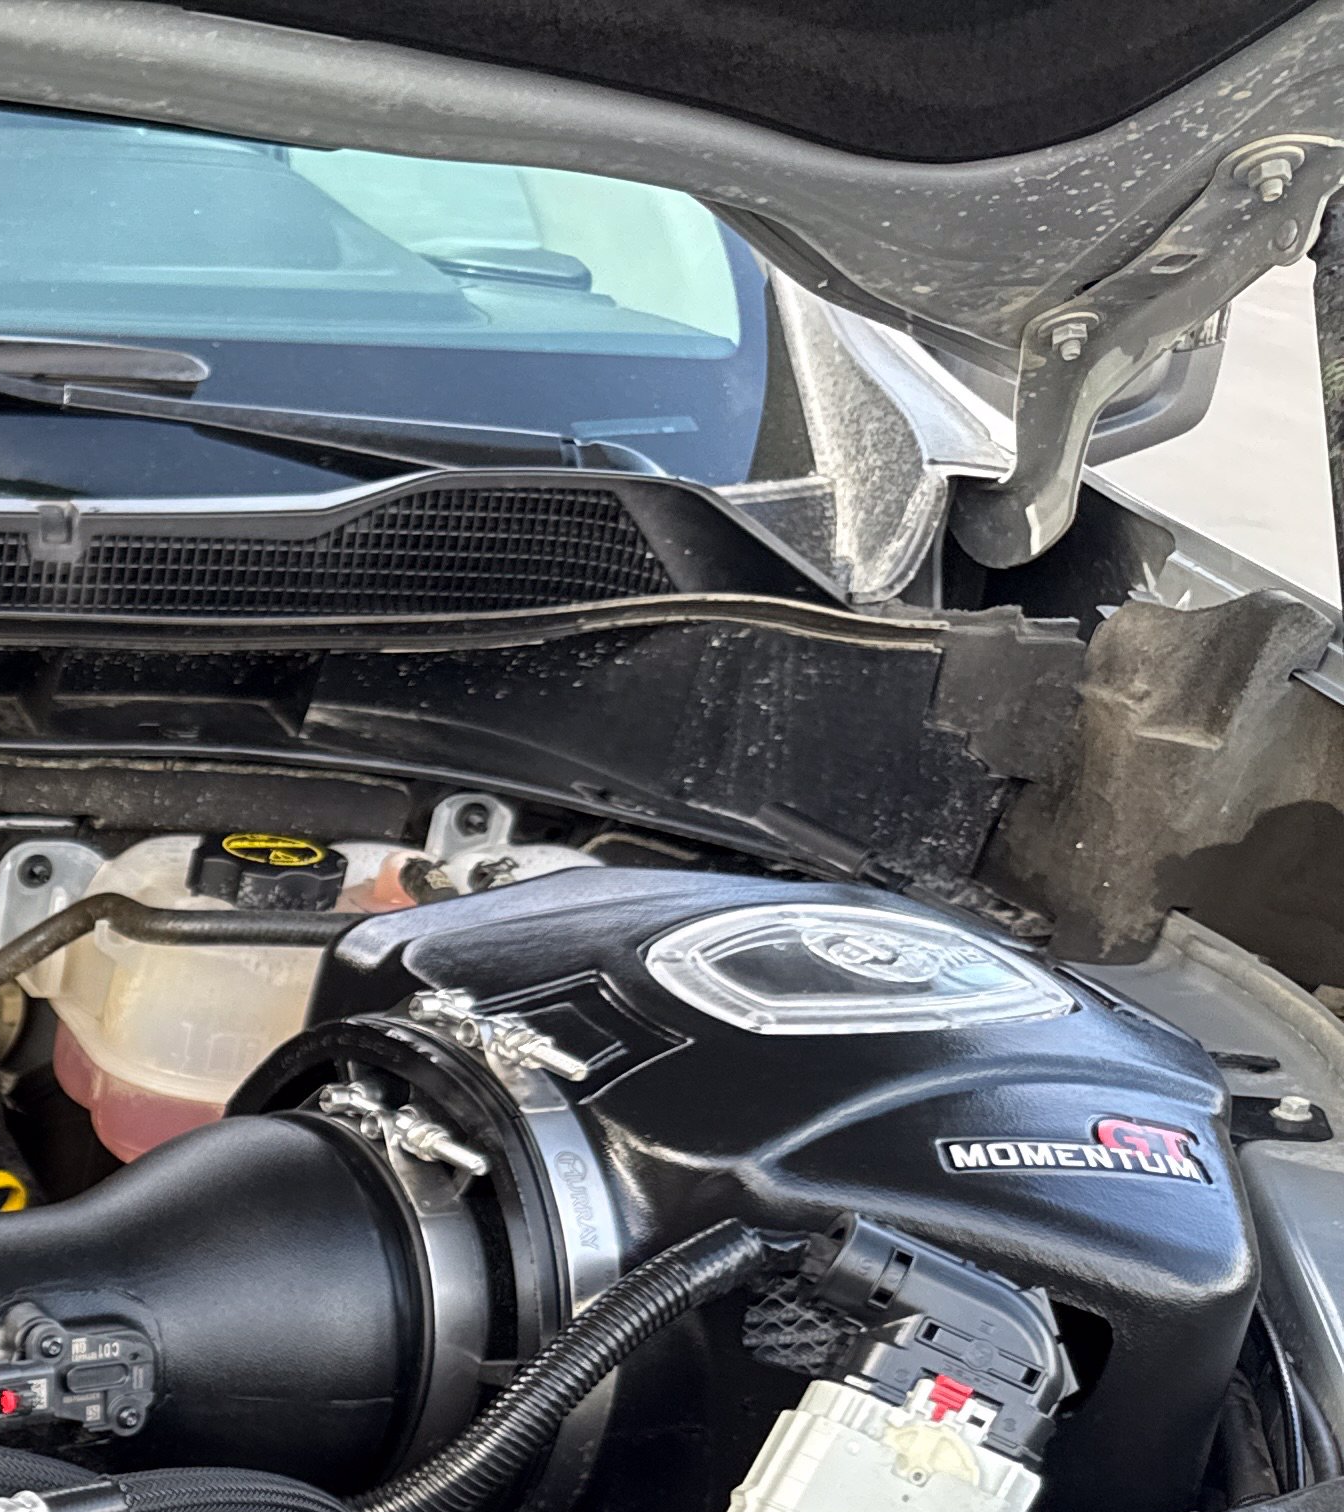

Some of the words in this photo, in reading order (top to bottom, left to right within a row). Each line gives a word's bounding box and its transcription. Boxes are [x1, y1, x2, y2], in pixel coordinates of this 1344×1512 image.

[948, 1142, 1204, 1180] MOMENTUM
[1097, 1119, 1195, 1163] GT
[553, 1151, 600, 1250] MURRAY
